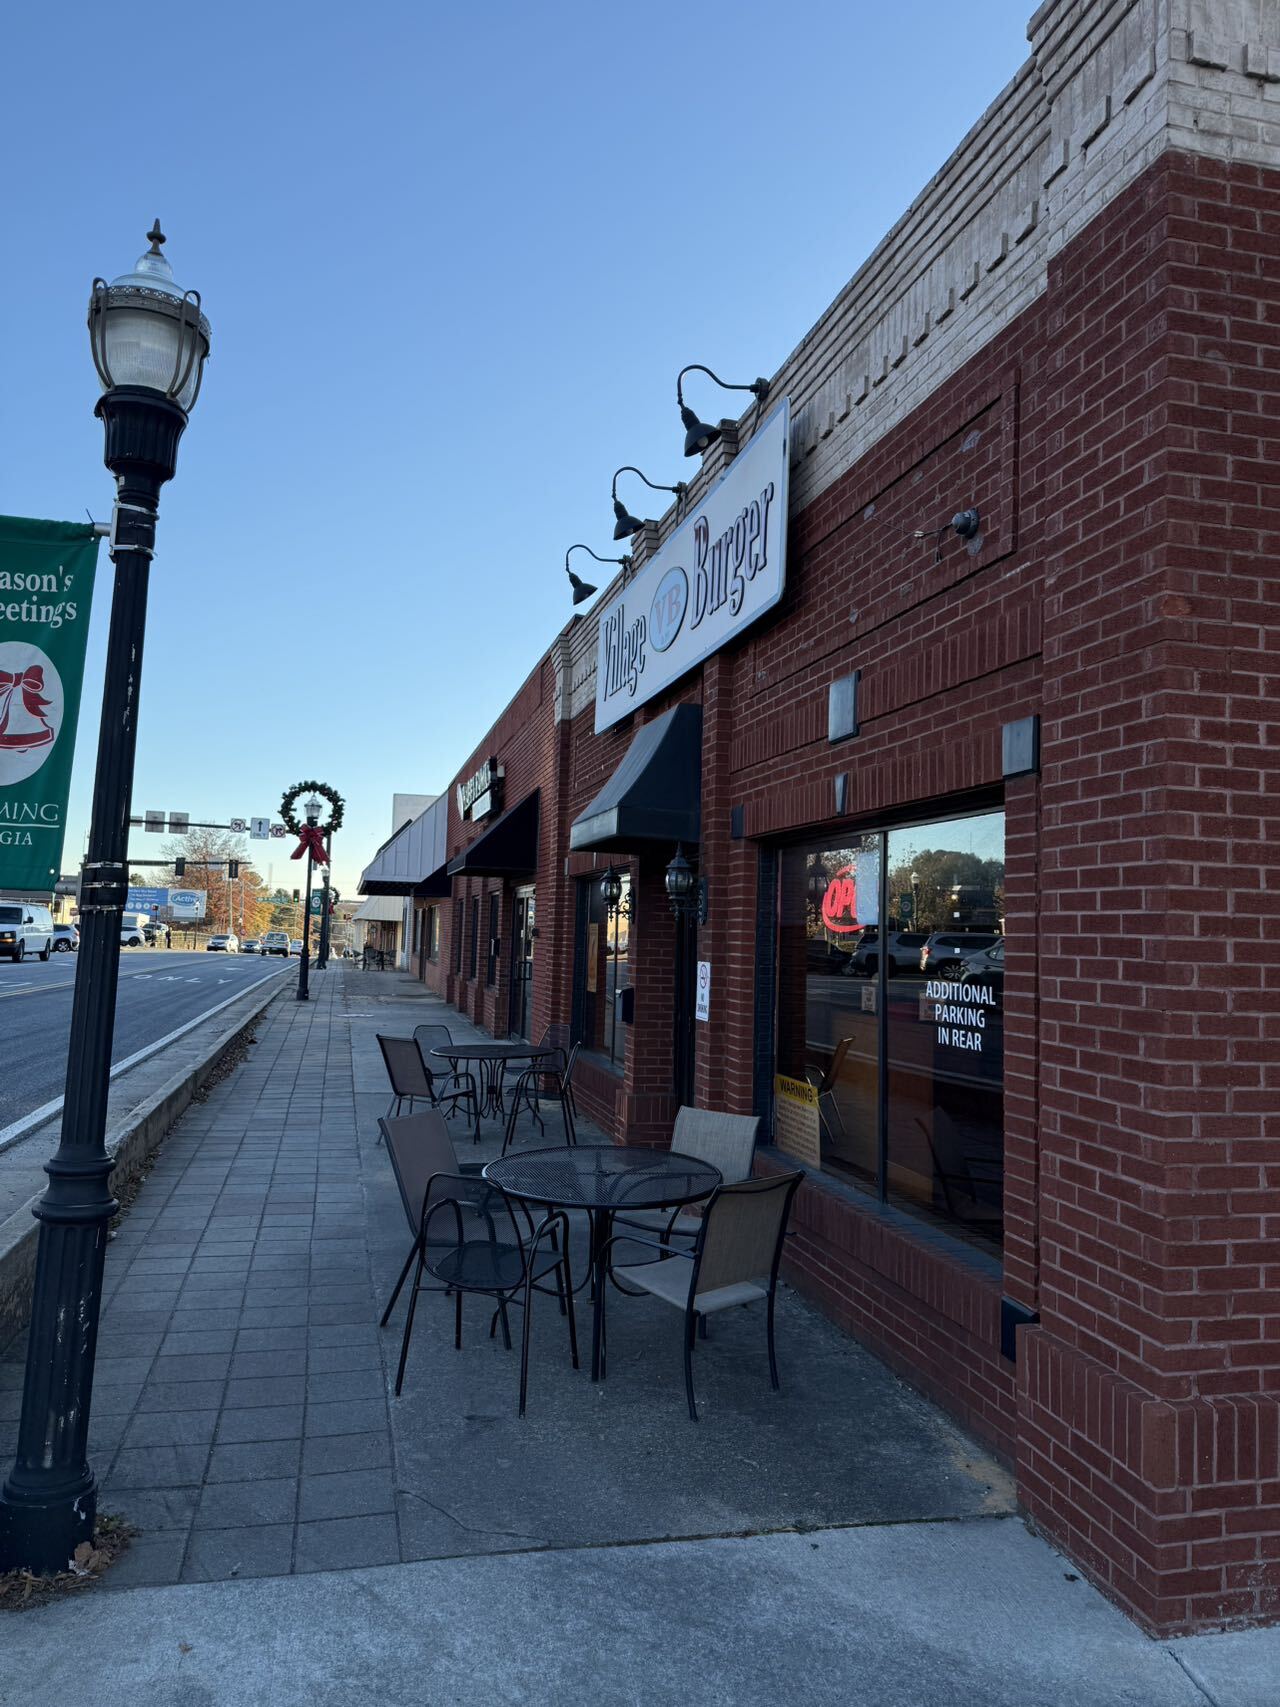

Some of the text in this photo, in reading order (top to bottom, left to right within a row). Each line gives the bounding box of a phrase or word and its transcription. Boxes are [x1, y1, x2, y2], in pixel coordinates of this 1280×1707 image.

[603, 481, 774, 702] Village VB Burger
[0, 831, 33, 845] GIA
[132, 974, 233, 985] ONLY
[925, 980, 996, 1006] ADDITIONAL
[934, 1003, 985, 1028] PARKING
[938, 1026, 982, 1052] IN REAR
[779, 1078, 813, 1103] WARNING
